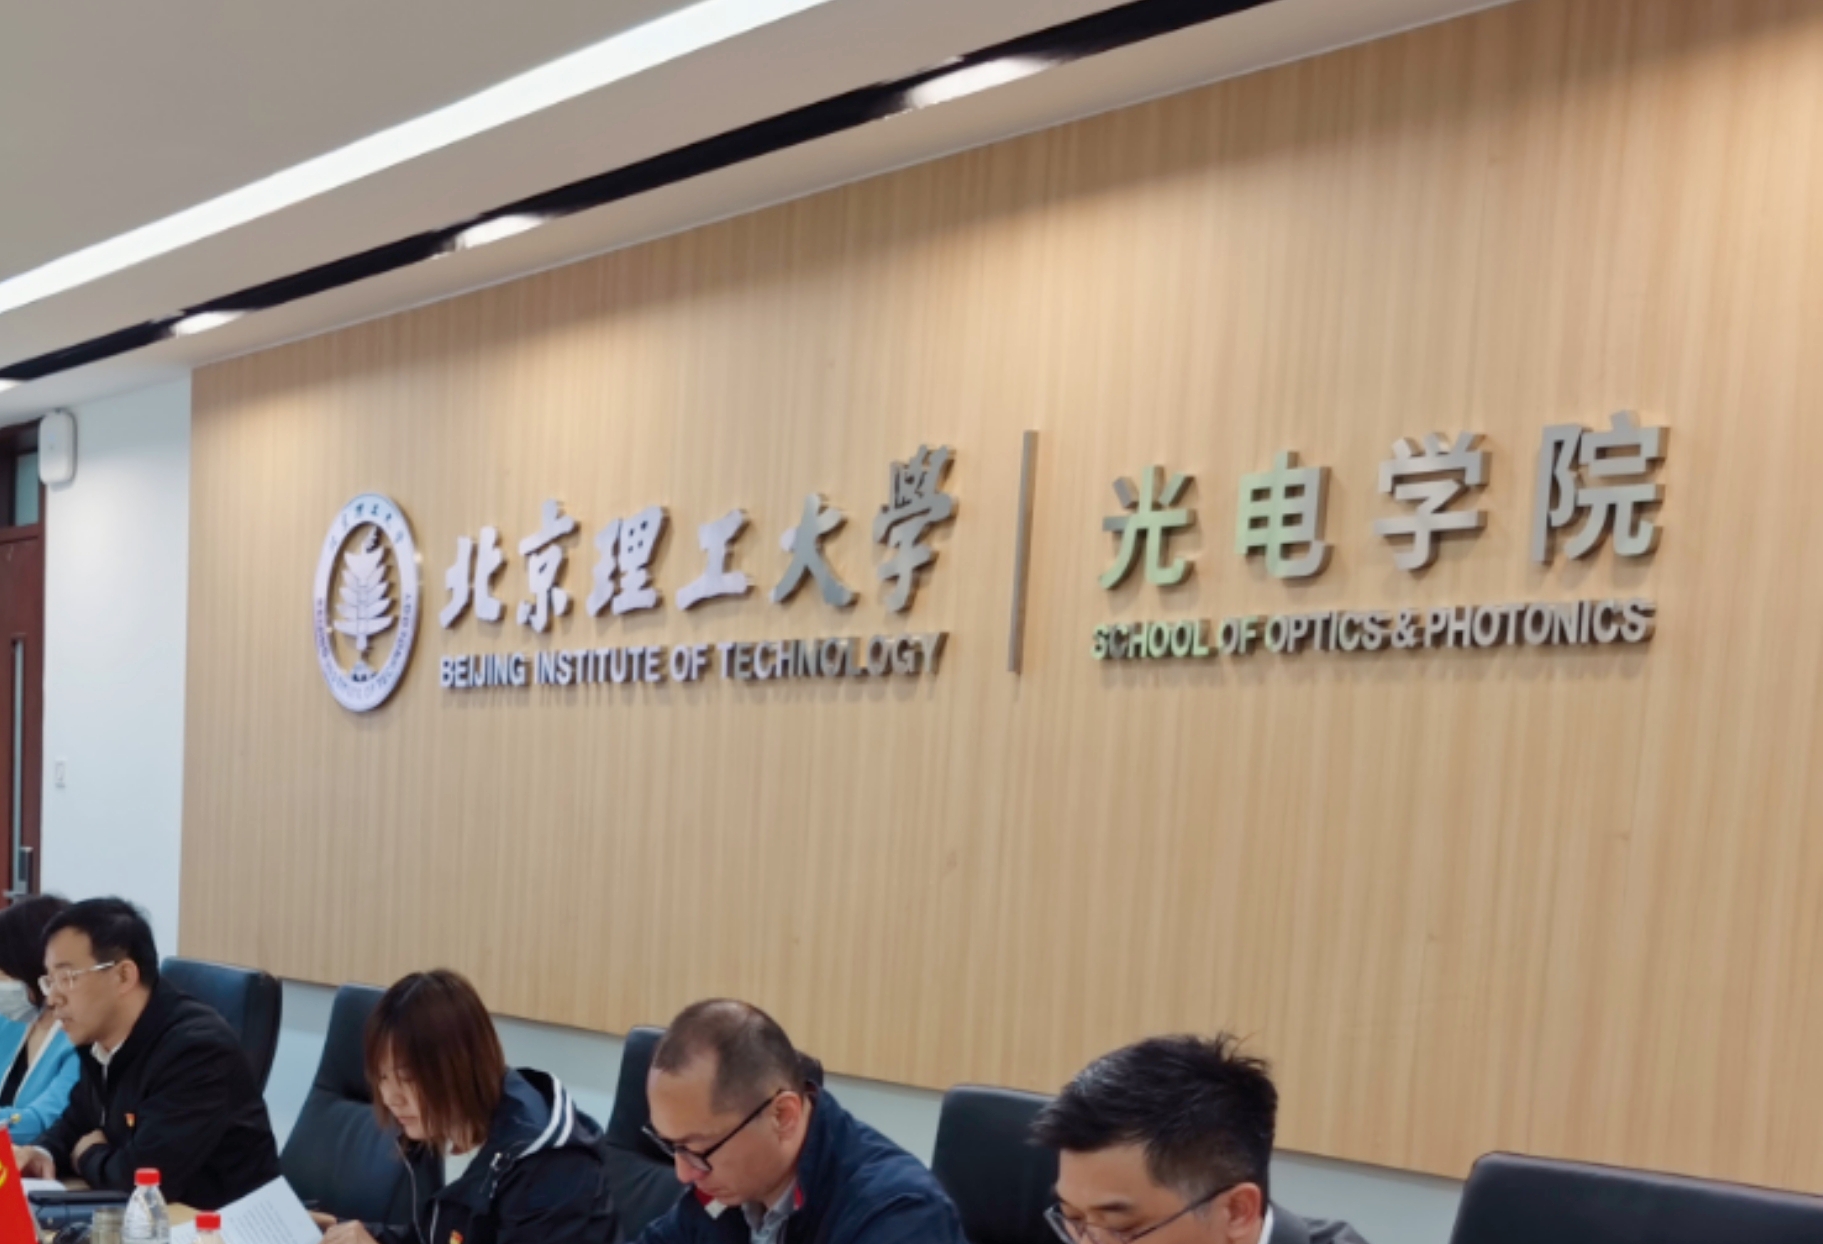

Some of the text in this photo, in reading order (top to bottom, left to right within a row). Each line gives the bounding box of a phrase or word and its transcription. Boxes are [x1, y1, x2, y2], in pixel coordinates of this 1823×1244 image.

[1099, 410, 1670, 589] 光电学院
[440, 631, 949, 690] BEIJING INSTITUTE OF TECHNOLOGY
[1091, 616, 1214, 662] SCHOOL
[1217, 614, 1264, 655] OF
[1264, 608, 1386, 653] OPTICS
[1423, 596, 1656, 649] PHOTONICS
